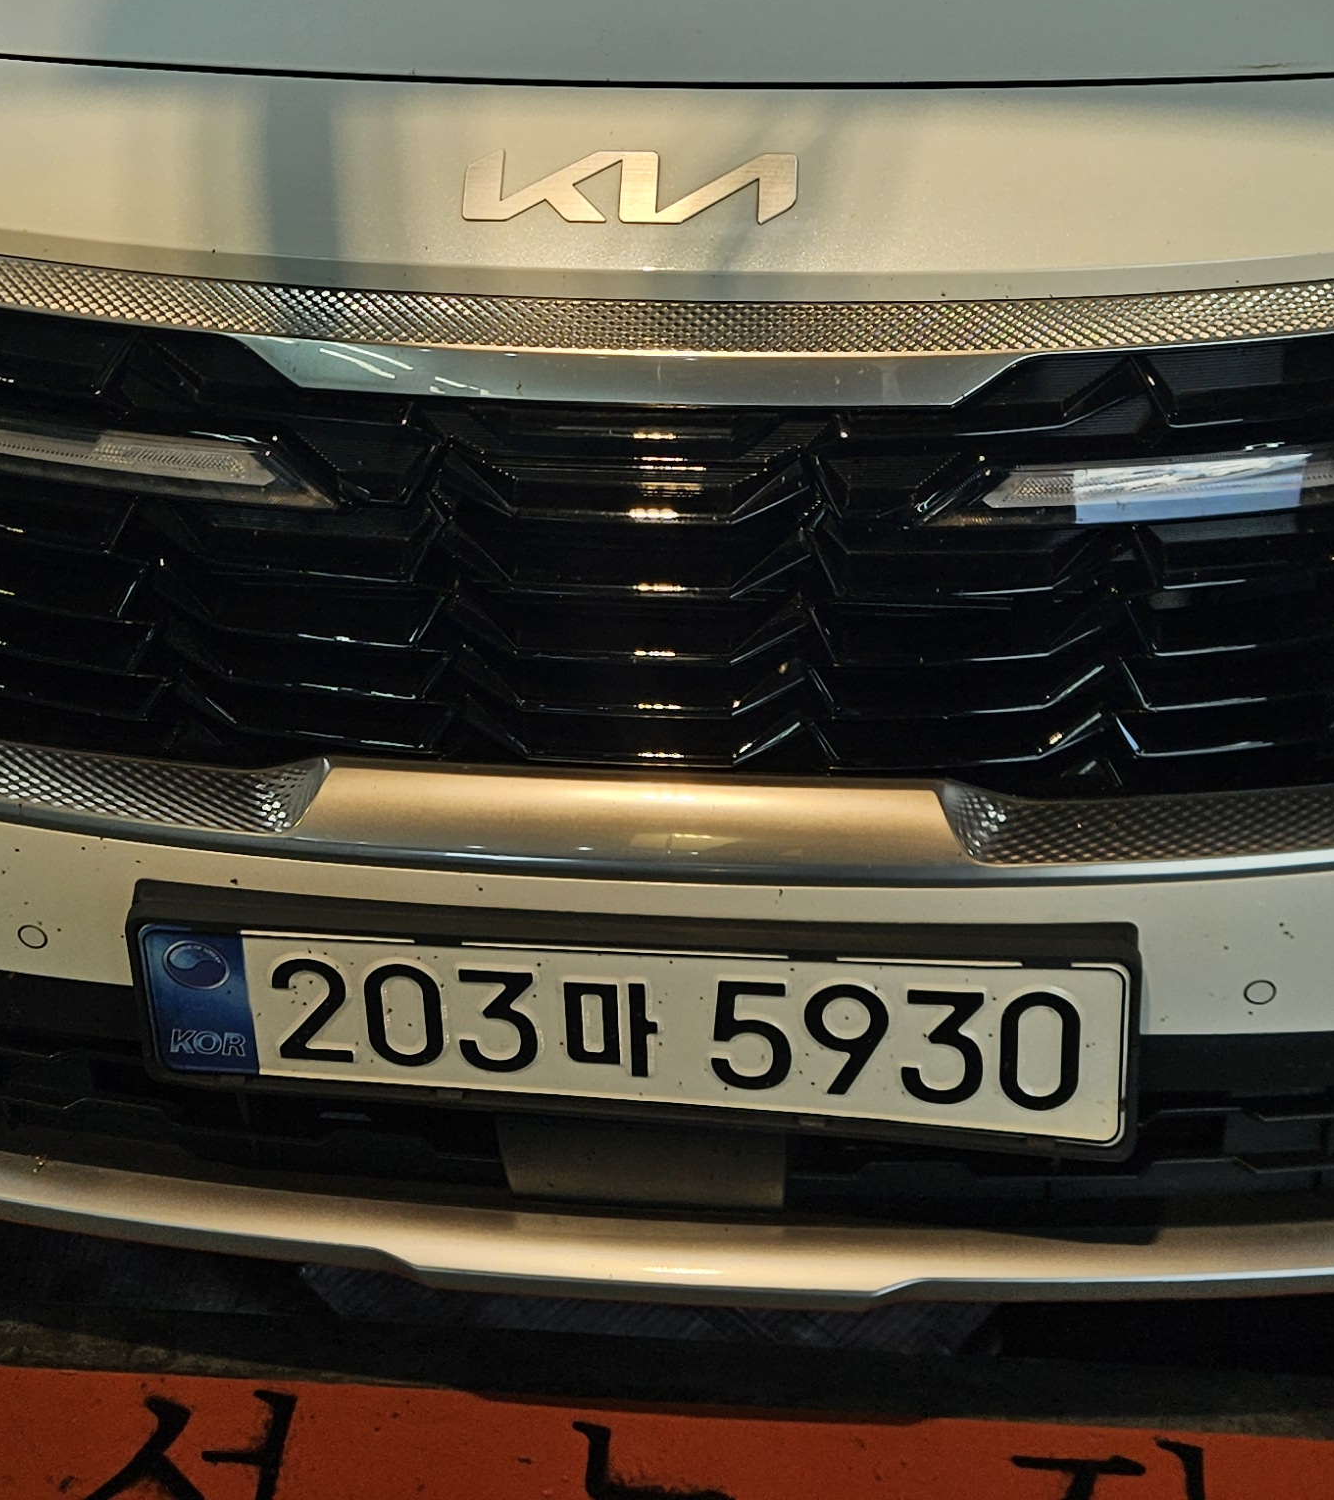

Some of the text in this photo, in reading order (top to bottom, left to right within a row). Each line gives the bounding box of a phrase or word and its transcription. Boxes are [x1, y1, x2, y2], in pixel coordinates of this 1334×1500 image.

[169, 1028, 246, 1058] KOR
[271, 958, 1082, 1113] 203마 5930
